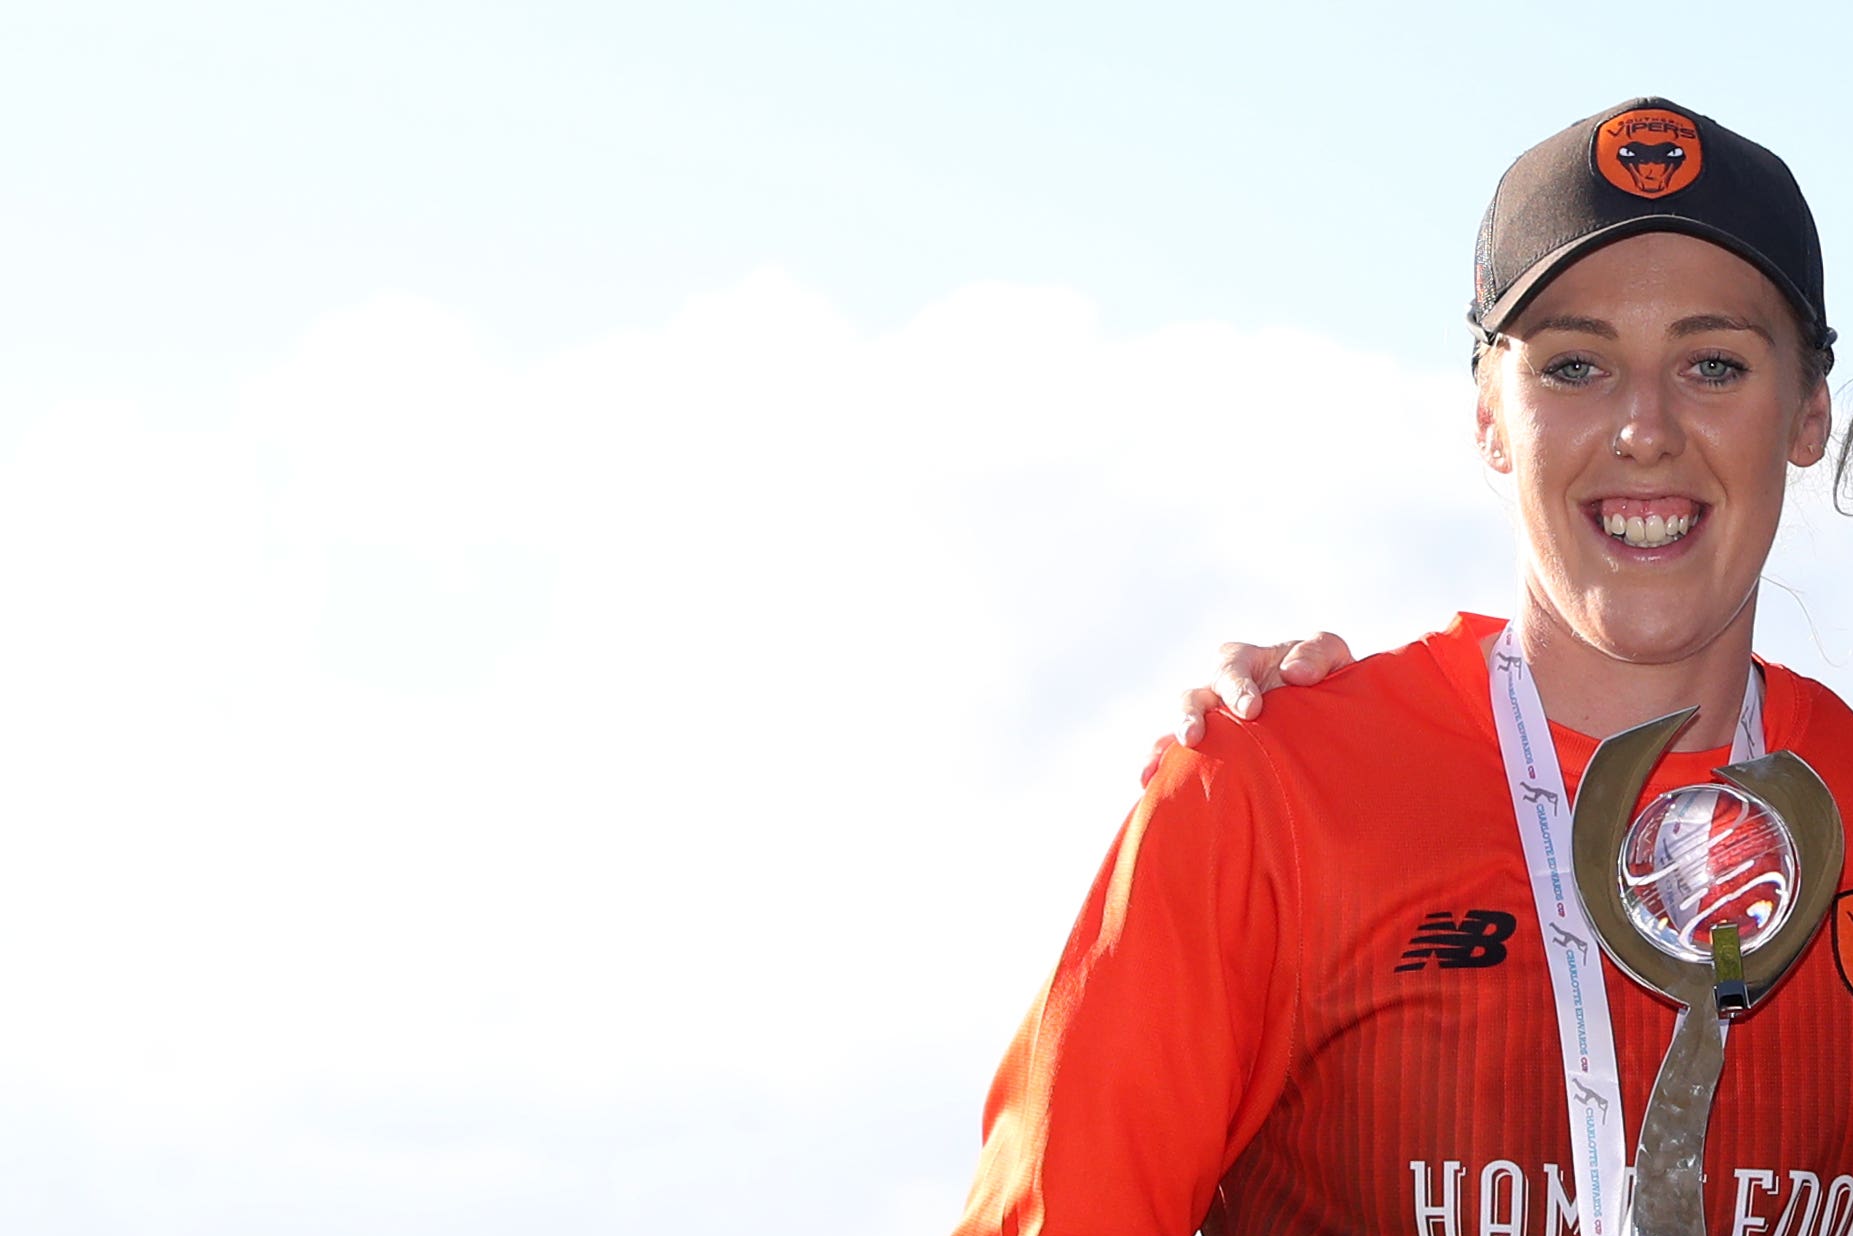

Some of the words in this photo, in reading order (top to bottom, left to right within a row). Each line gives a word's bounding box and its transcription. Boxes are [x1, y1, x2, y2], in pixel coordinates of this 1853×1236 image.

[1607, 121, 1697, 140] VIPERS
[1536, 803, 1555, 856] CHARLOTTE
[1548, 856, 1565, 901] EDWARDS
[1556, 902, 1567, 918] CUP
[1567, 949, 1581, 1005] CHARLOTTE
[1575, 1007, 1589, 1055] EDWARDS
[1580, 1056, 1589, 1073] CUP
[1585, 1107, 1599, 1167] CHARLOTTE
[1590, 1168, 1603, 1217] EDWARDS
